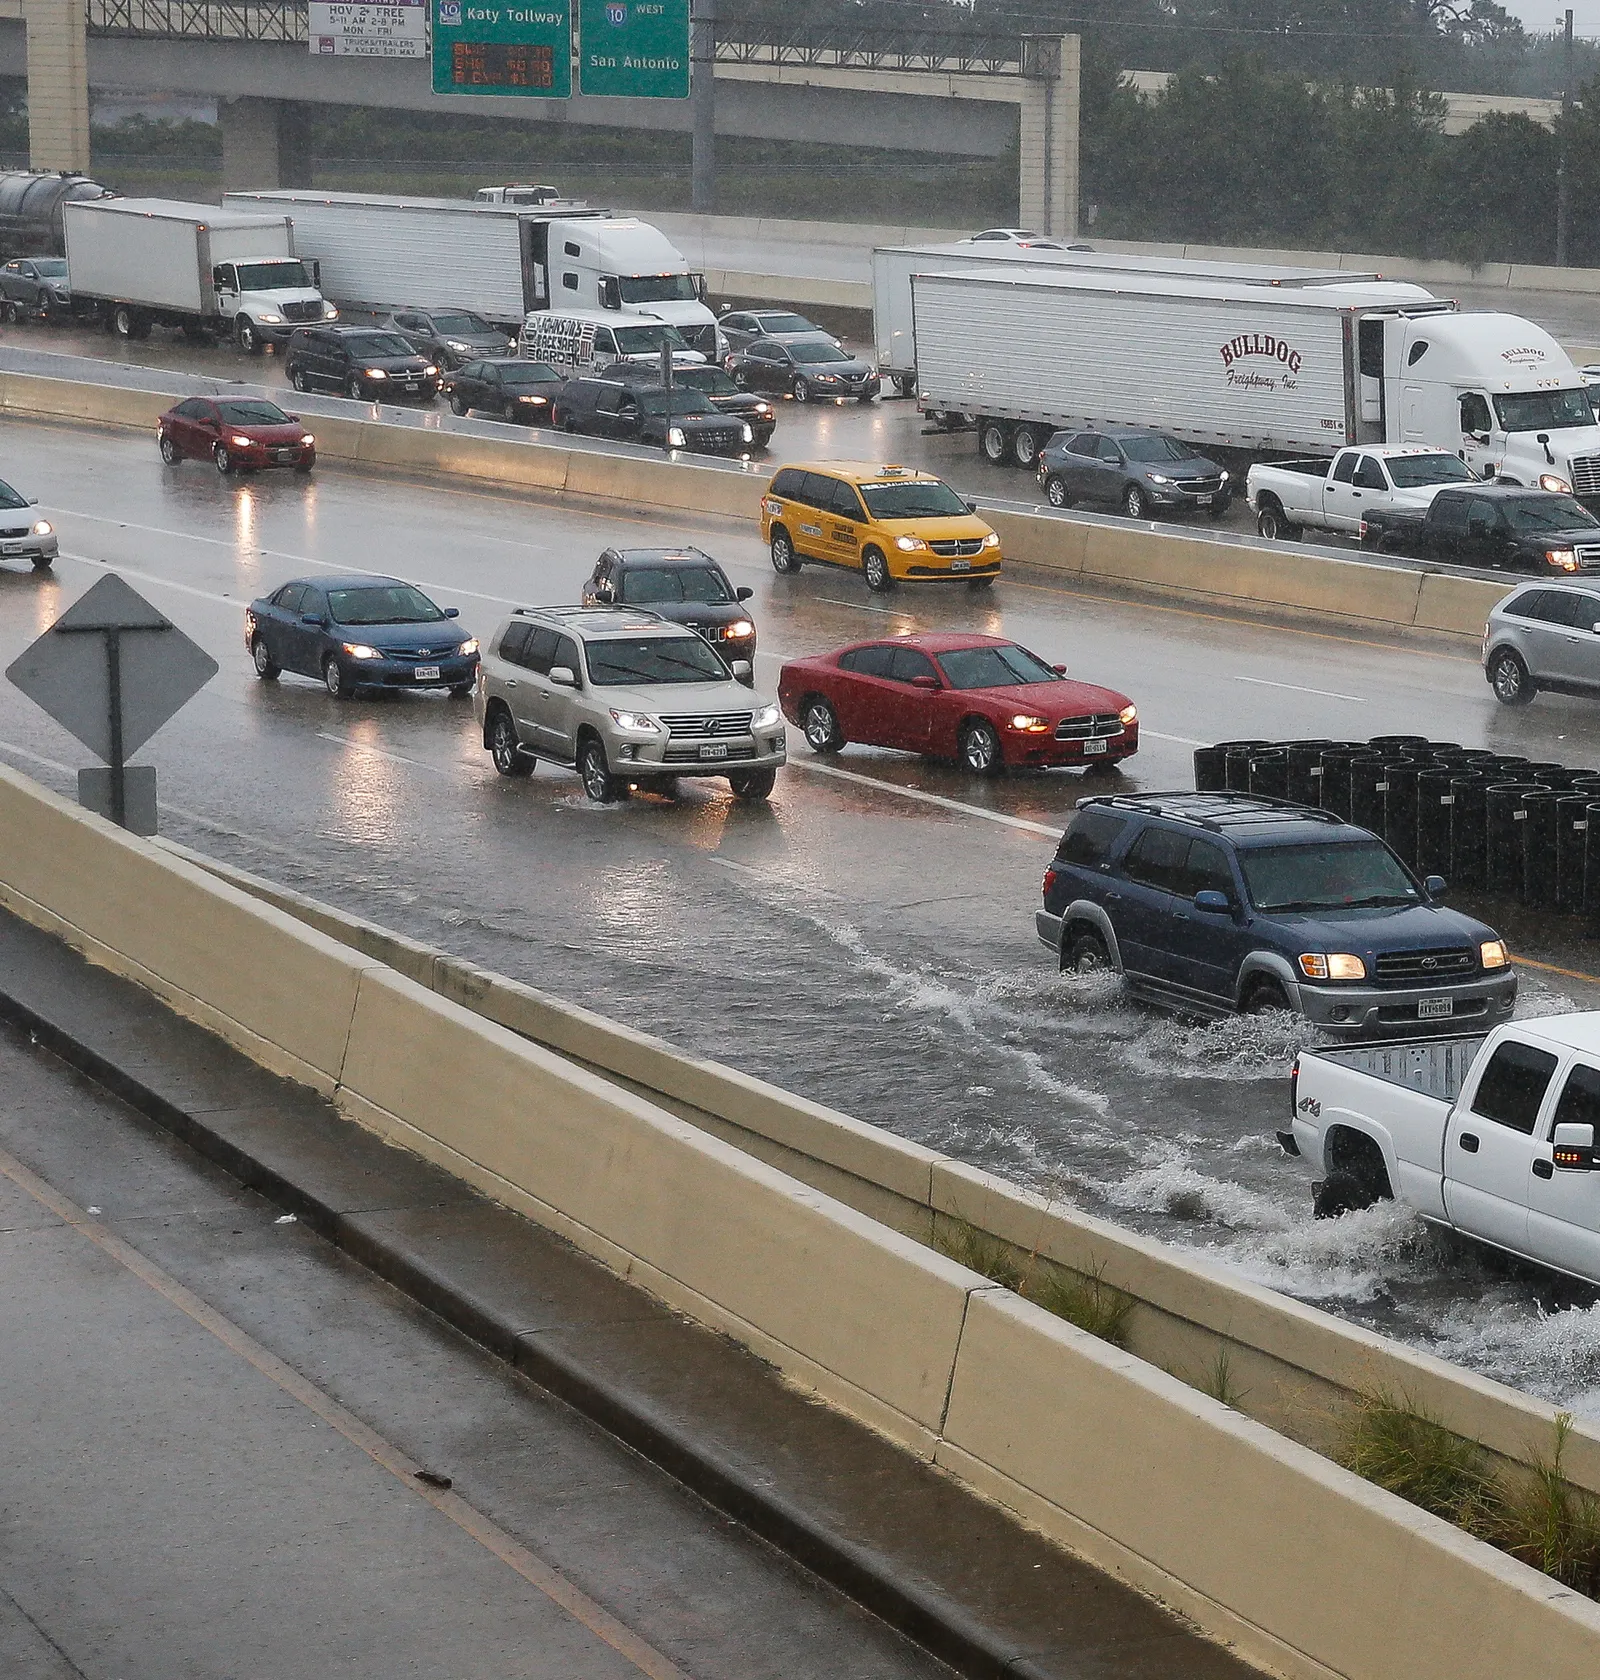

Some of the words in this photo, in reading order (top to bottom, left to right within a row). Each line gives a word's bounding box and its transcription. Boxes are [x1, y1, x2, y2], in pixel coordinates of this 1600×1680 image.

[329, 5, 353, 15] HOV
[376, 7, 404, 18] FREE
[444, 4, 458, 15] 10
[610, 9, 623, 22] 10
[636, 4, 664, 14] WEST
[352, 17, 366, 25] AM
[391, 18, 405, 27] PM
[467, 7, 499, 24] Katy
[506, 8, 562, 26] Tollway
[343, 26, 364, 34] MON
[377, 27, 392, 35] FRI
[590, 55, 616, 67] San
[623, 56, 679, 70] Antonio
[1219, 333, 1302, 375] BULLDOG
